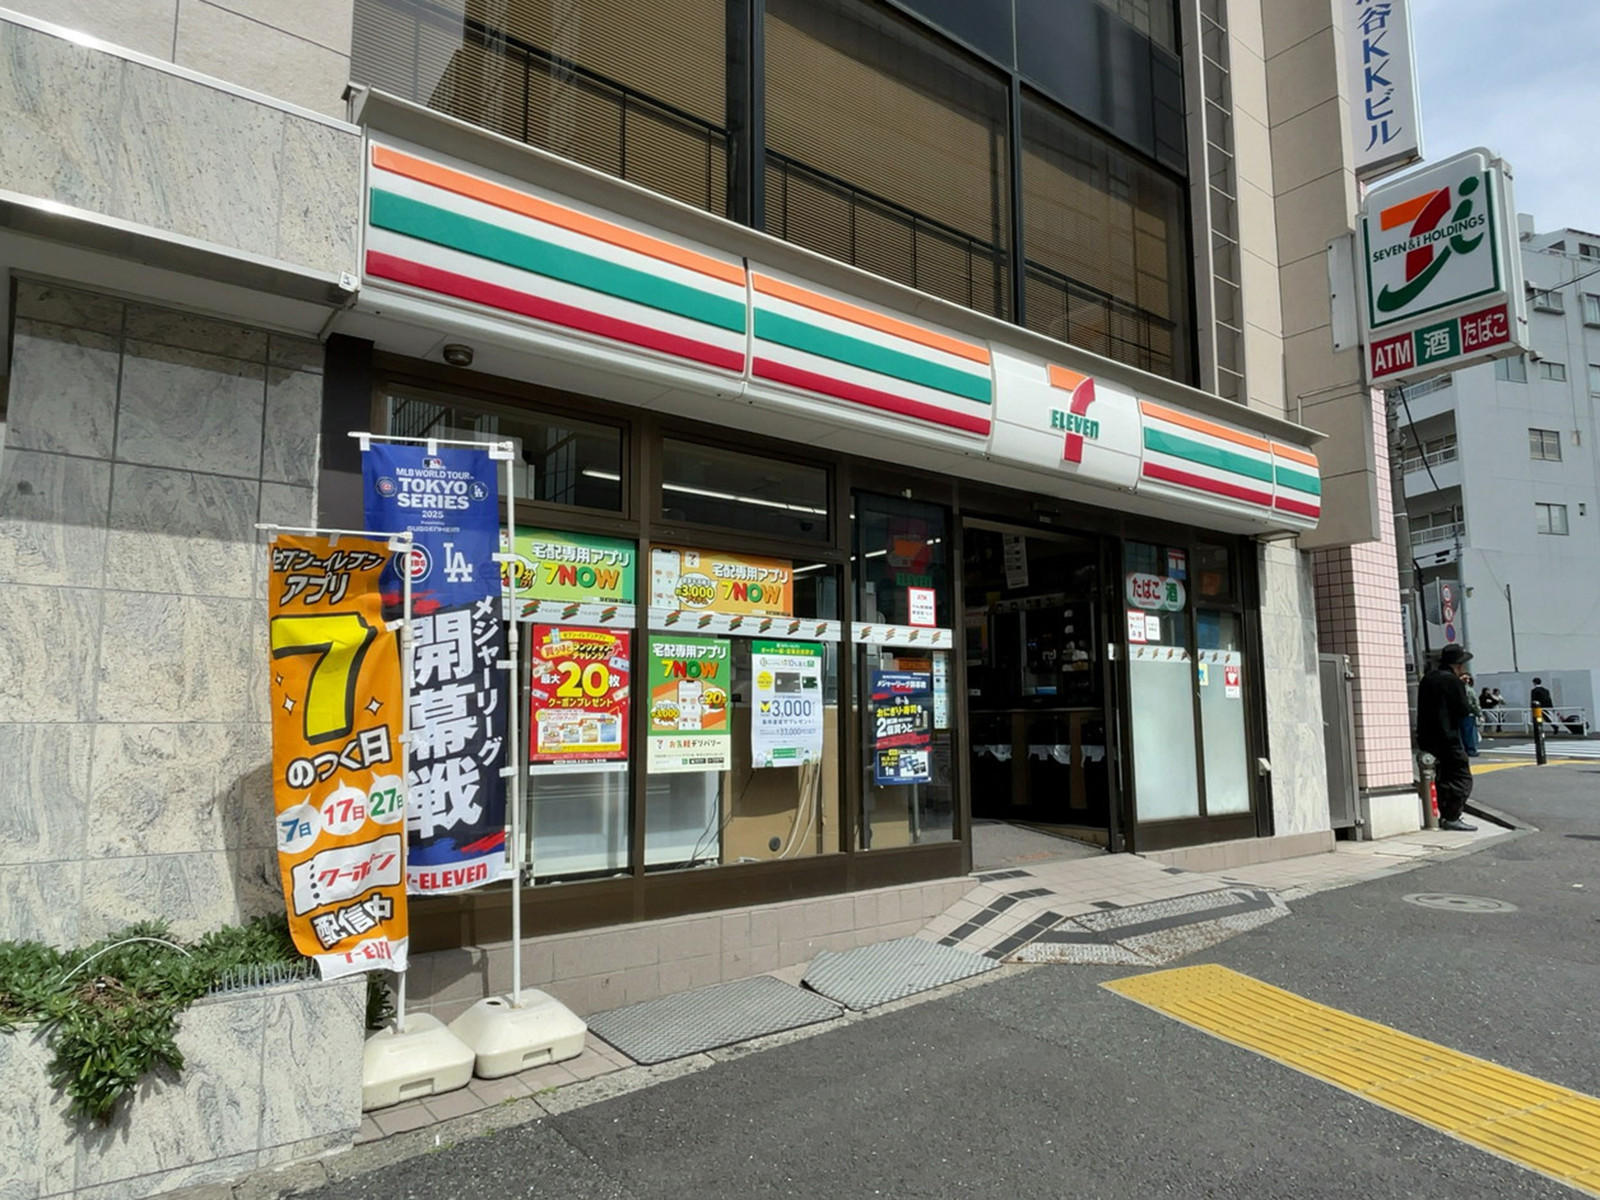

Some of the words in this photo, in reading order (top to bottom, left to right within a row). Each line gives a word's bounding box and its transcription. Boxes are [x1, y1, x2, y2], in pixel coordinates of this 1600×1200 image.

[1356, 0, 1402, 152] 谷KKビル
[1423, 214, 1485, 246] HOLDINGS
[1423, 327, 1450, 359] 酒
[1463, 313, 1507, 347] たばこ
[1374, 339, 1412, 372] ATM
[396, 467, 414, 477] MLB
[415, 469, 446, 479] WORLD
[398, 477, 468, 495] TOKYO
[397, 493, 470, 510] SERIES
[422, 510, 444, 519] 2025
[532, 542, 630, 567] 宅配専用アプリ
[712, 563, 789, 584] 宅配専用アプリ
[279, 572, 350, 606] アプリ
[1132, 577, 1161, 600] たばこ
[1165, 581, 1178, 603] 酒
[652, 642, 727, 659] 宅配専用アプリ
[271, 611, 379, 745] 7
[472, 595, 503, 766] メジャーリーグ
[548, 697, 613, 708] クーポンプレゼント
[772, 699, 811, 718] 3,000
[408, 609, 483, 839] 開幕戦
[286, 724, 393, 789] のつく日
[324, 799, 365, 826] 17日
[281, 818, 312, 843] 7日
[318, 854, 396, 887] クーポン
[311, 893, 393, 950] 配信中
